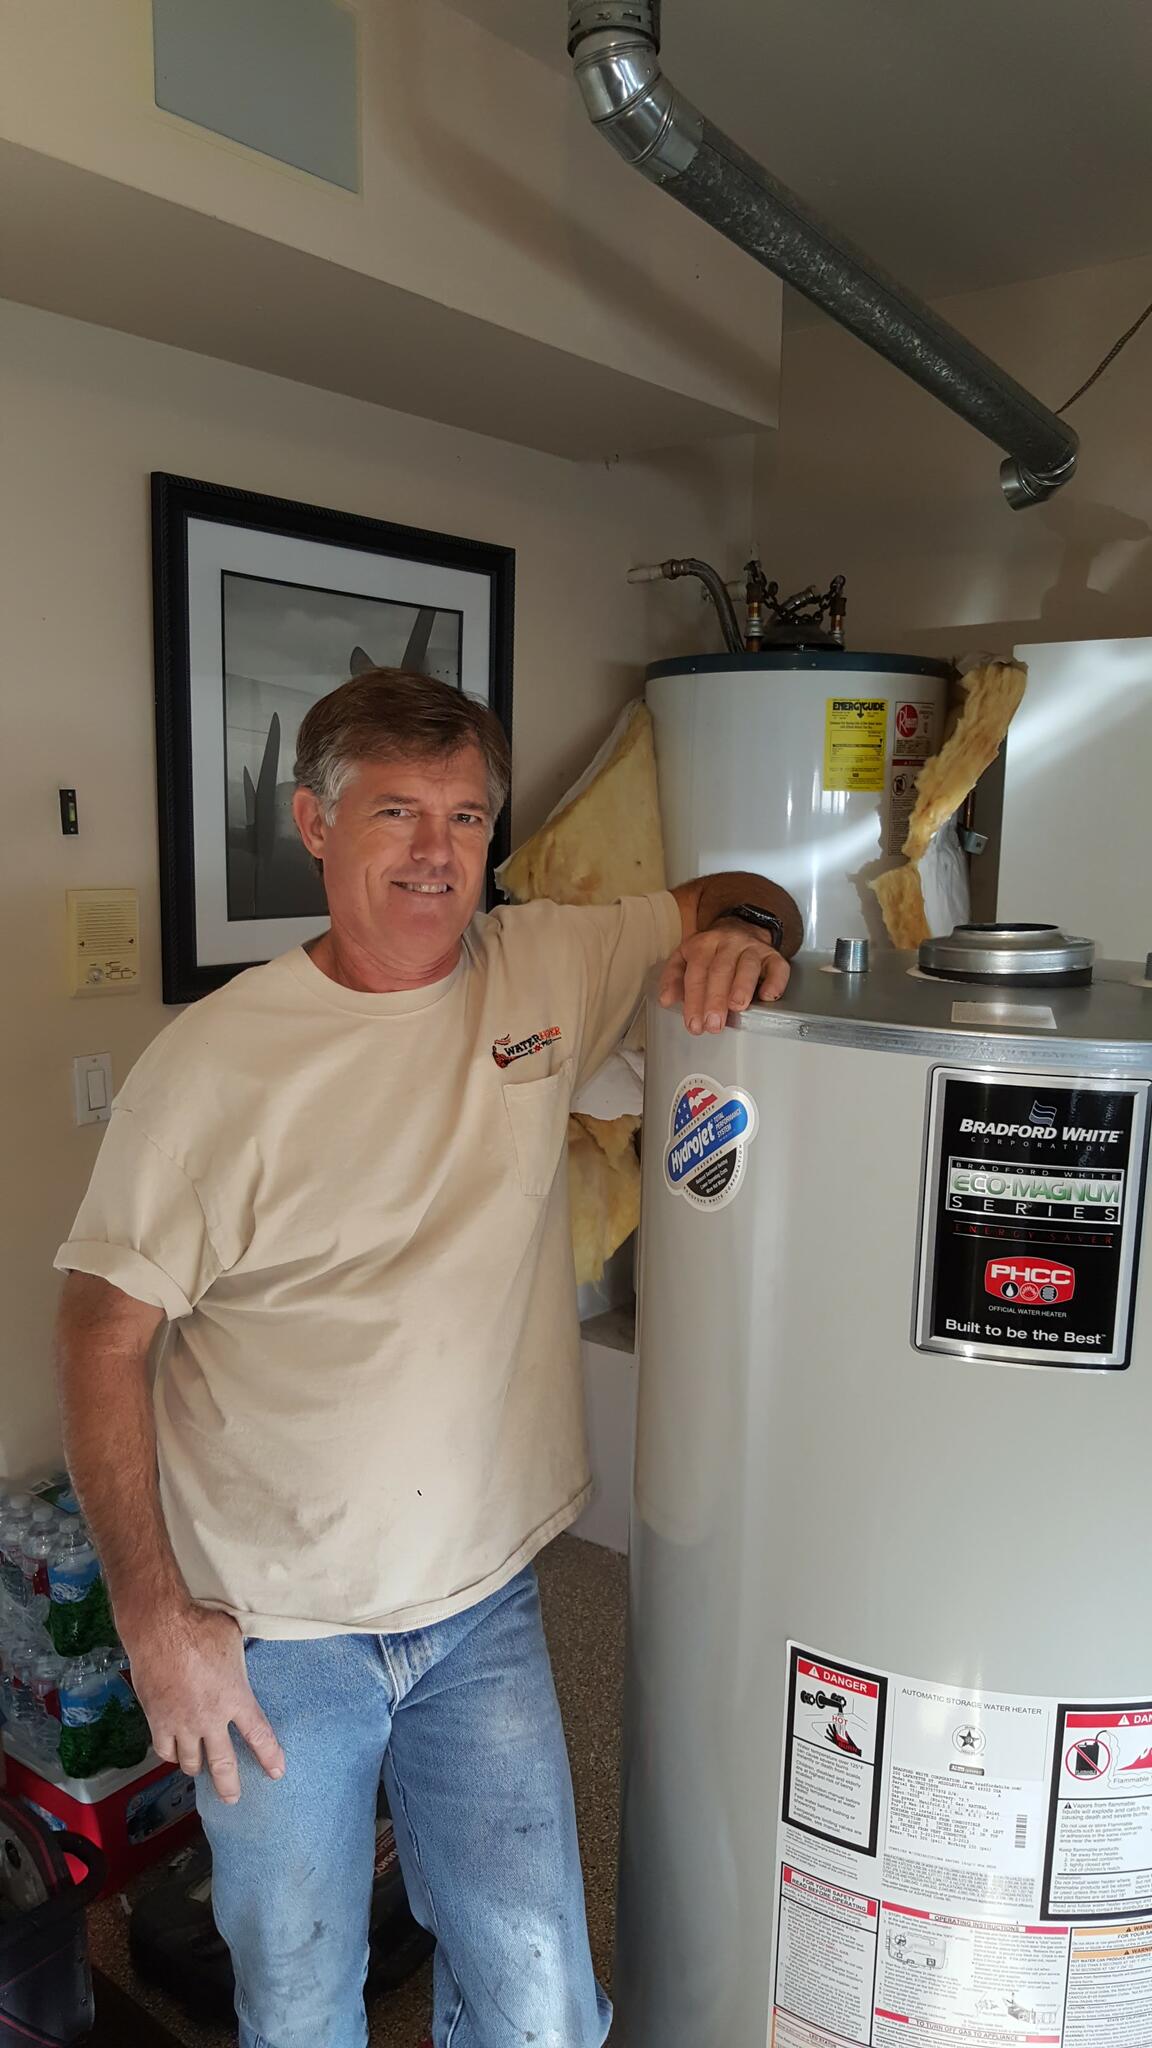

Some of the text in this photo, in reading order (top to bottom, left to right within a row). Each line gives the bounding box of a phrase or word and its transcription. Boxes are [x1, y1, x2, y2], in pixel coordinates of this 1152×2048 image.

[504, 1034, 542, 1056] WATER
[959, 1118, 1120, 1144] BRADFORD WHITE
[670, 1121, 716, 1174] Hydrojet
[971, 1136, 1106, 1152] CORPORATION
[956, 1162, 1118, 1181] BRADFORD WHITE
[951, 1195, 1116, 1220] SERIES
[955, 1224, 1113, 1245] ENERGY SAVER
[991, 1264, 1071, 1285] PHCC
[988, 1305, 1067, 1318] OFFICIAL WATER HEATER
[945, 1318, 1102, 1345] Built to be the Best
[823, 1671, 868, 1693] DANGER
[901, 1688, 945, 1703] AUTOMATIC
[983, 1703, 1011, 1713] WATER
[1011, 1706, 1042, 1715] HEATER
[832, 1714, 848, 1726] HOT
[1113, 1776, 1150, 1784] Flammable
[802, 1877, 854, 1903] FOR YOUR SAFETY
[808, 1884, 830, 1898] BEFORE
[832, 1893, 866, 1913] OPERATING
[934, 1915, 972, 1929] OPERATING
[915, 2019, 1019, 2042] TO TURN OFF GAS TO APPLIANCE
